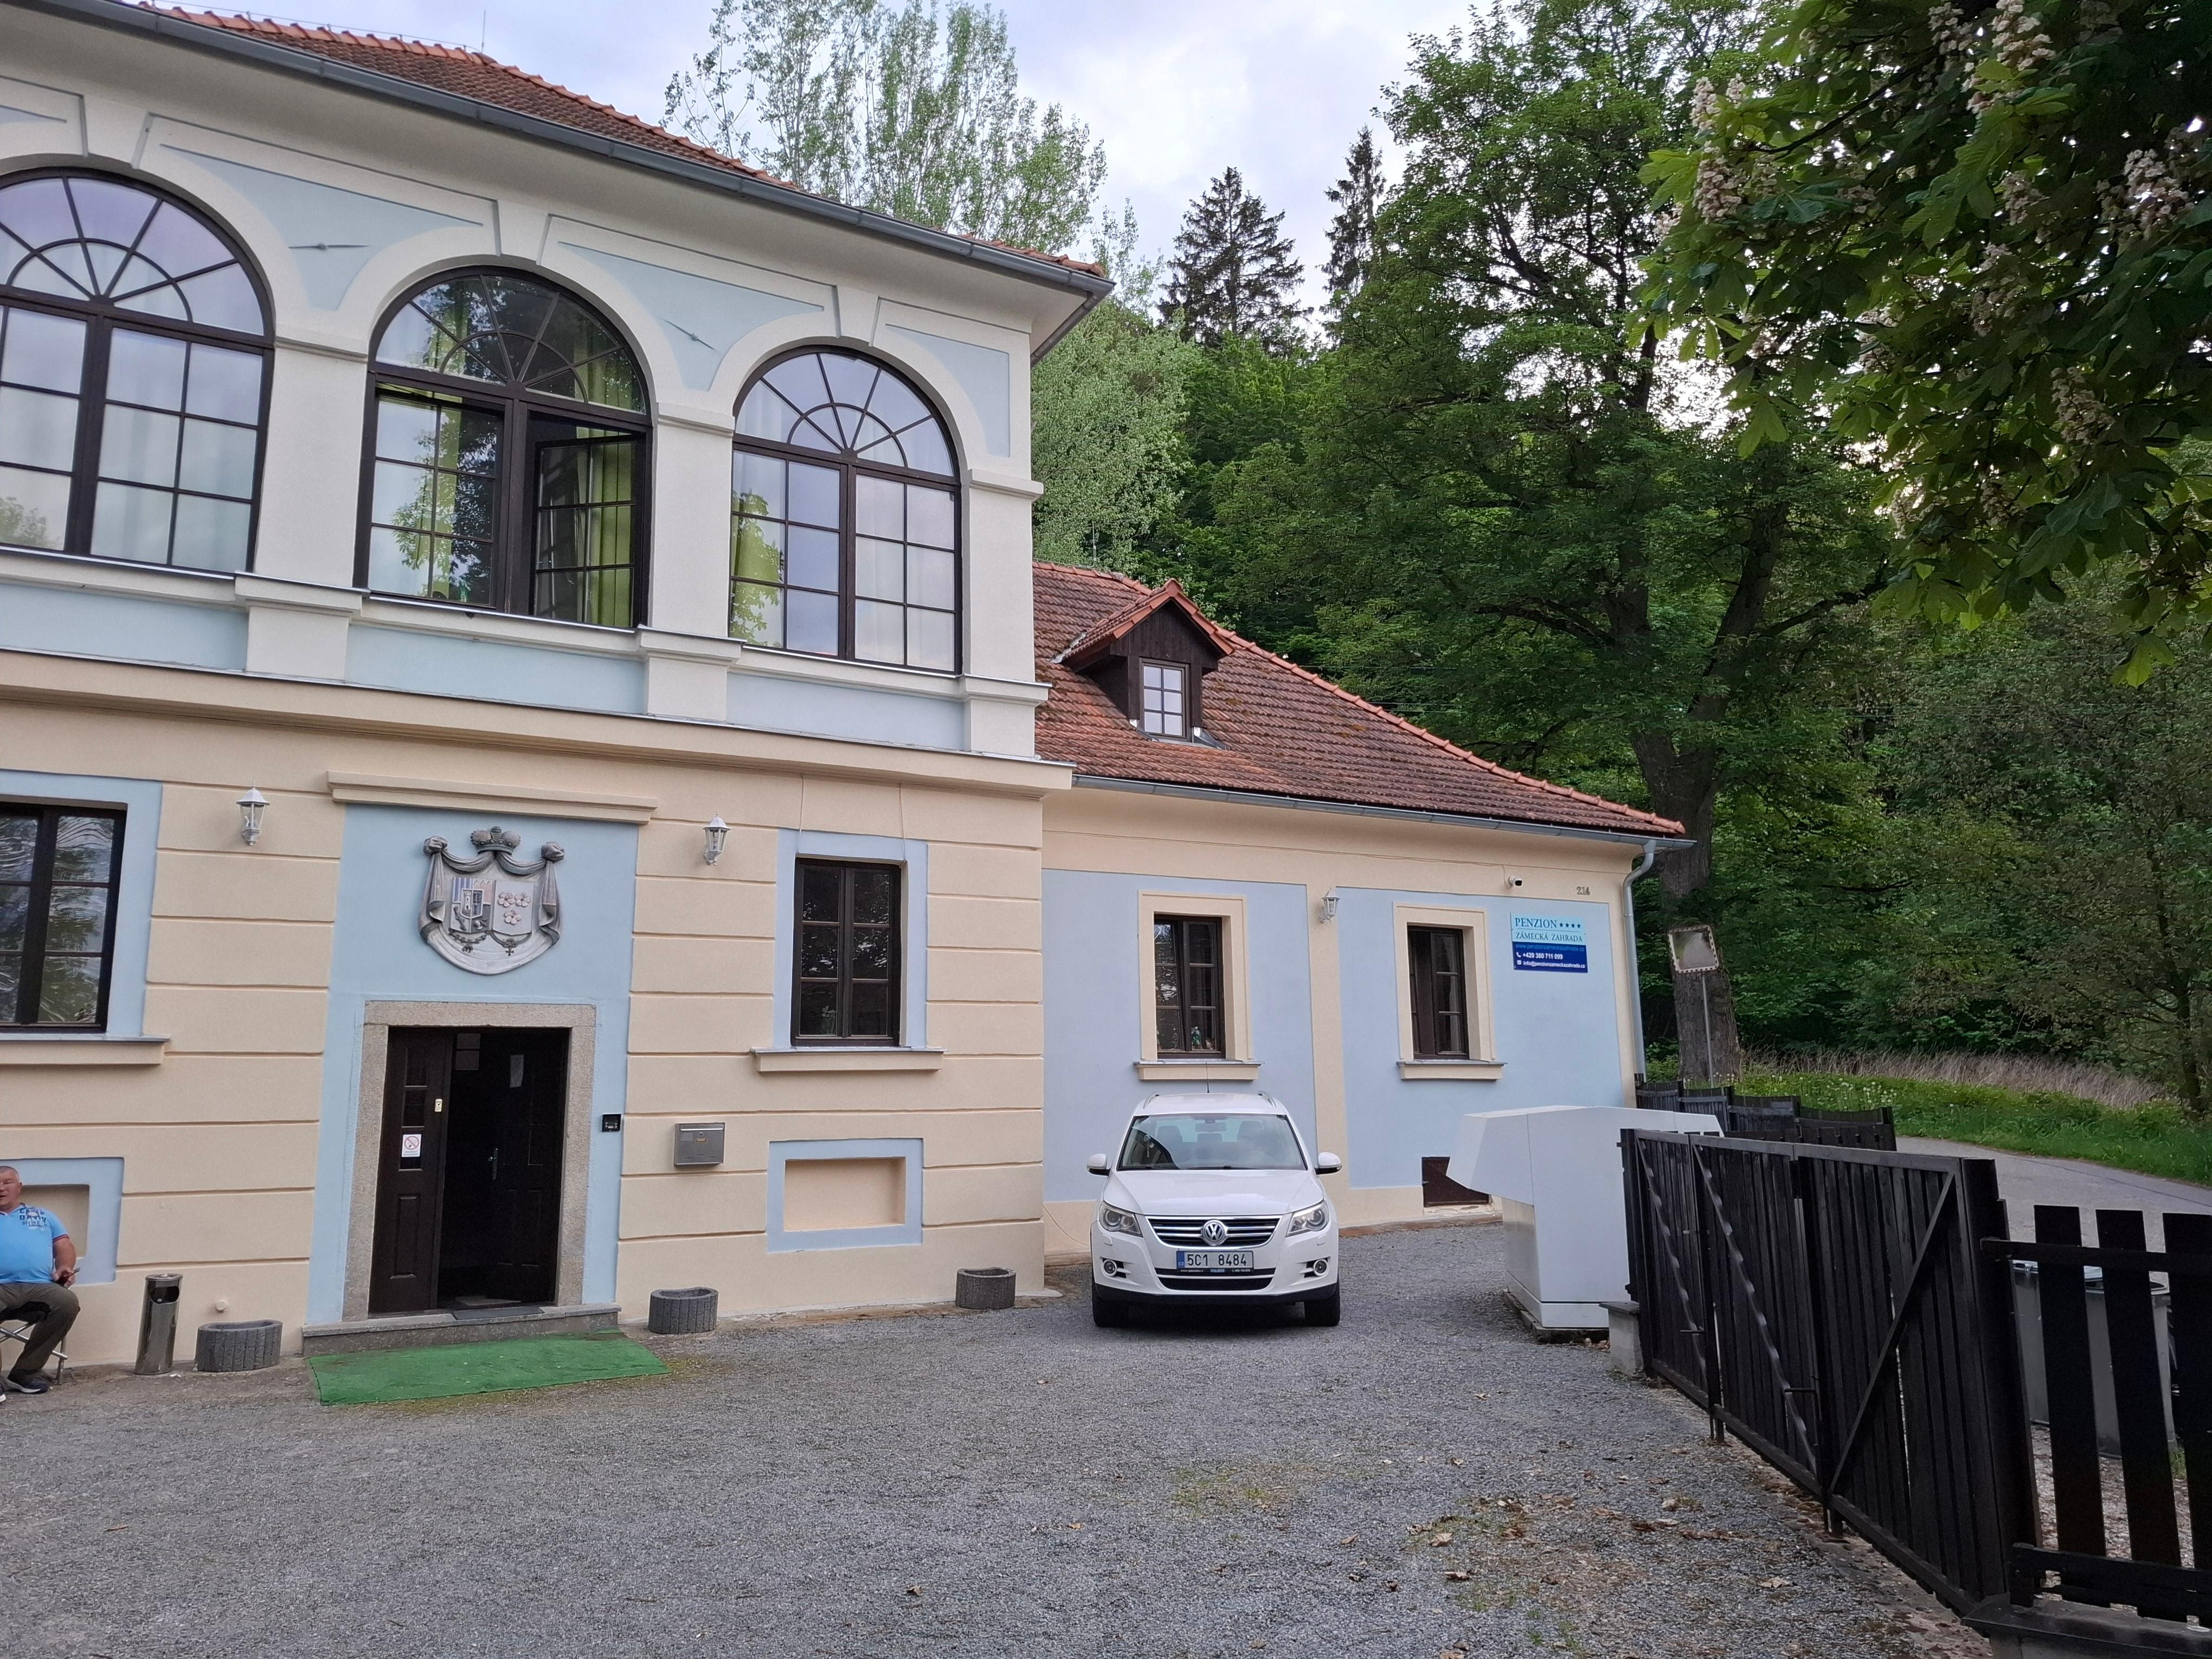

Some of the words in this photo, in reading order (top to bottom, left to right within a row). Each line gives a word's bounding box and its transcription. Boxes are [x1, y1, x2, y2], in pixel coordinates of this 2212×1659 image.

[1515, 917, 1557, 929] PENZION
[1515, 931, 1548, 941] ZÁMECKÁ
[1551, 934, 1583, 942] ZAHRADA
[1187, 1254, 1208, 1266] 5C1
[1218, 1254, 1247, 1266] 8484
